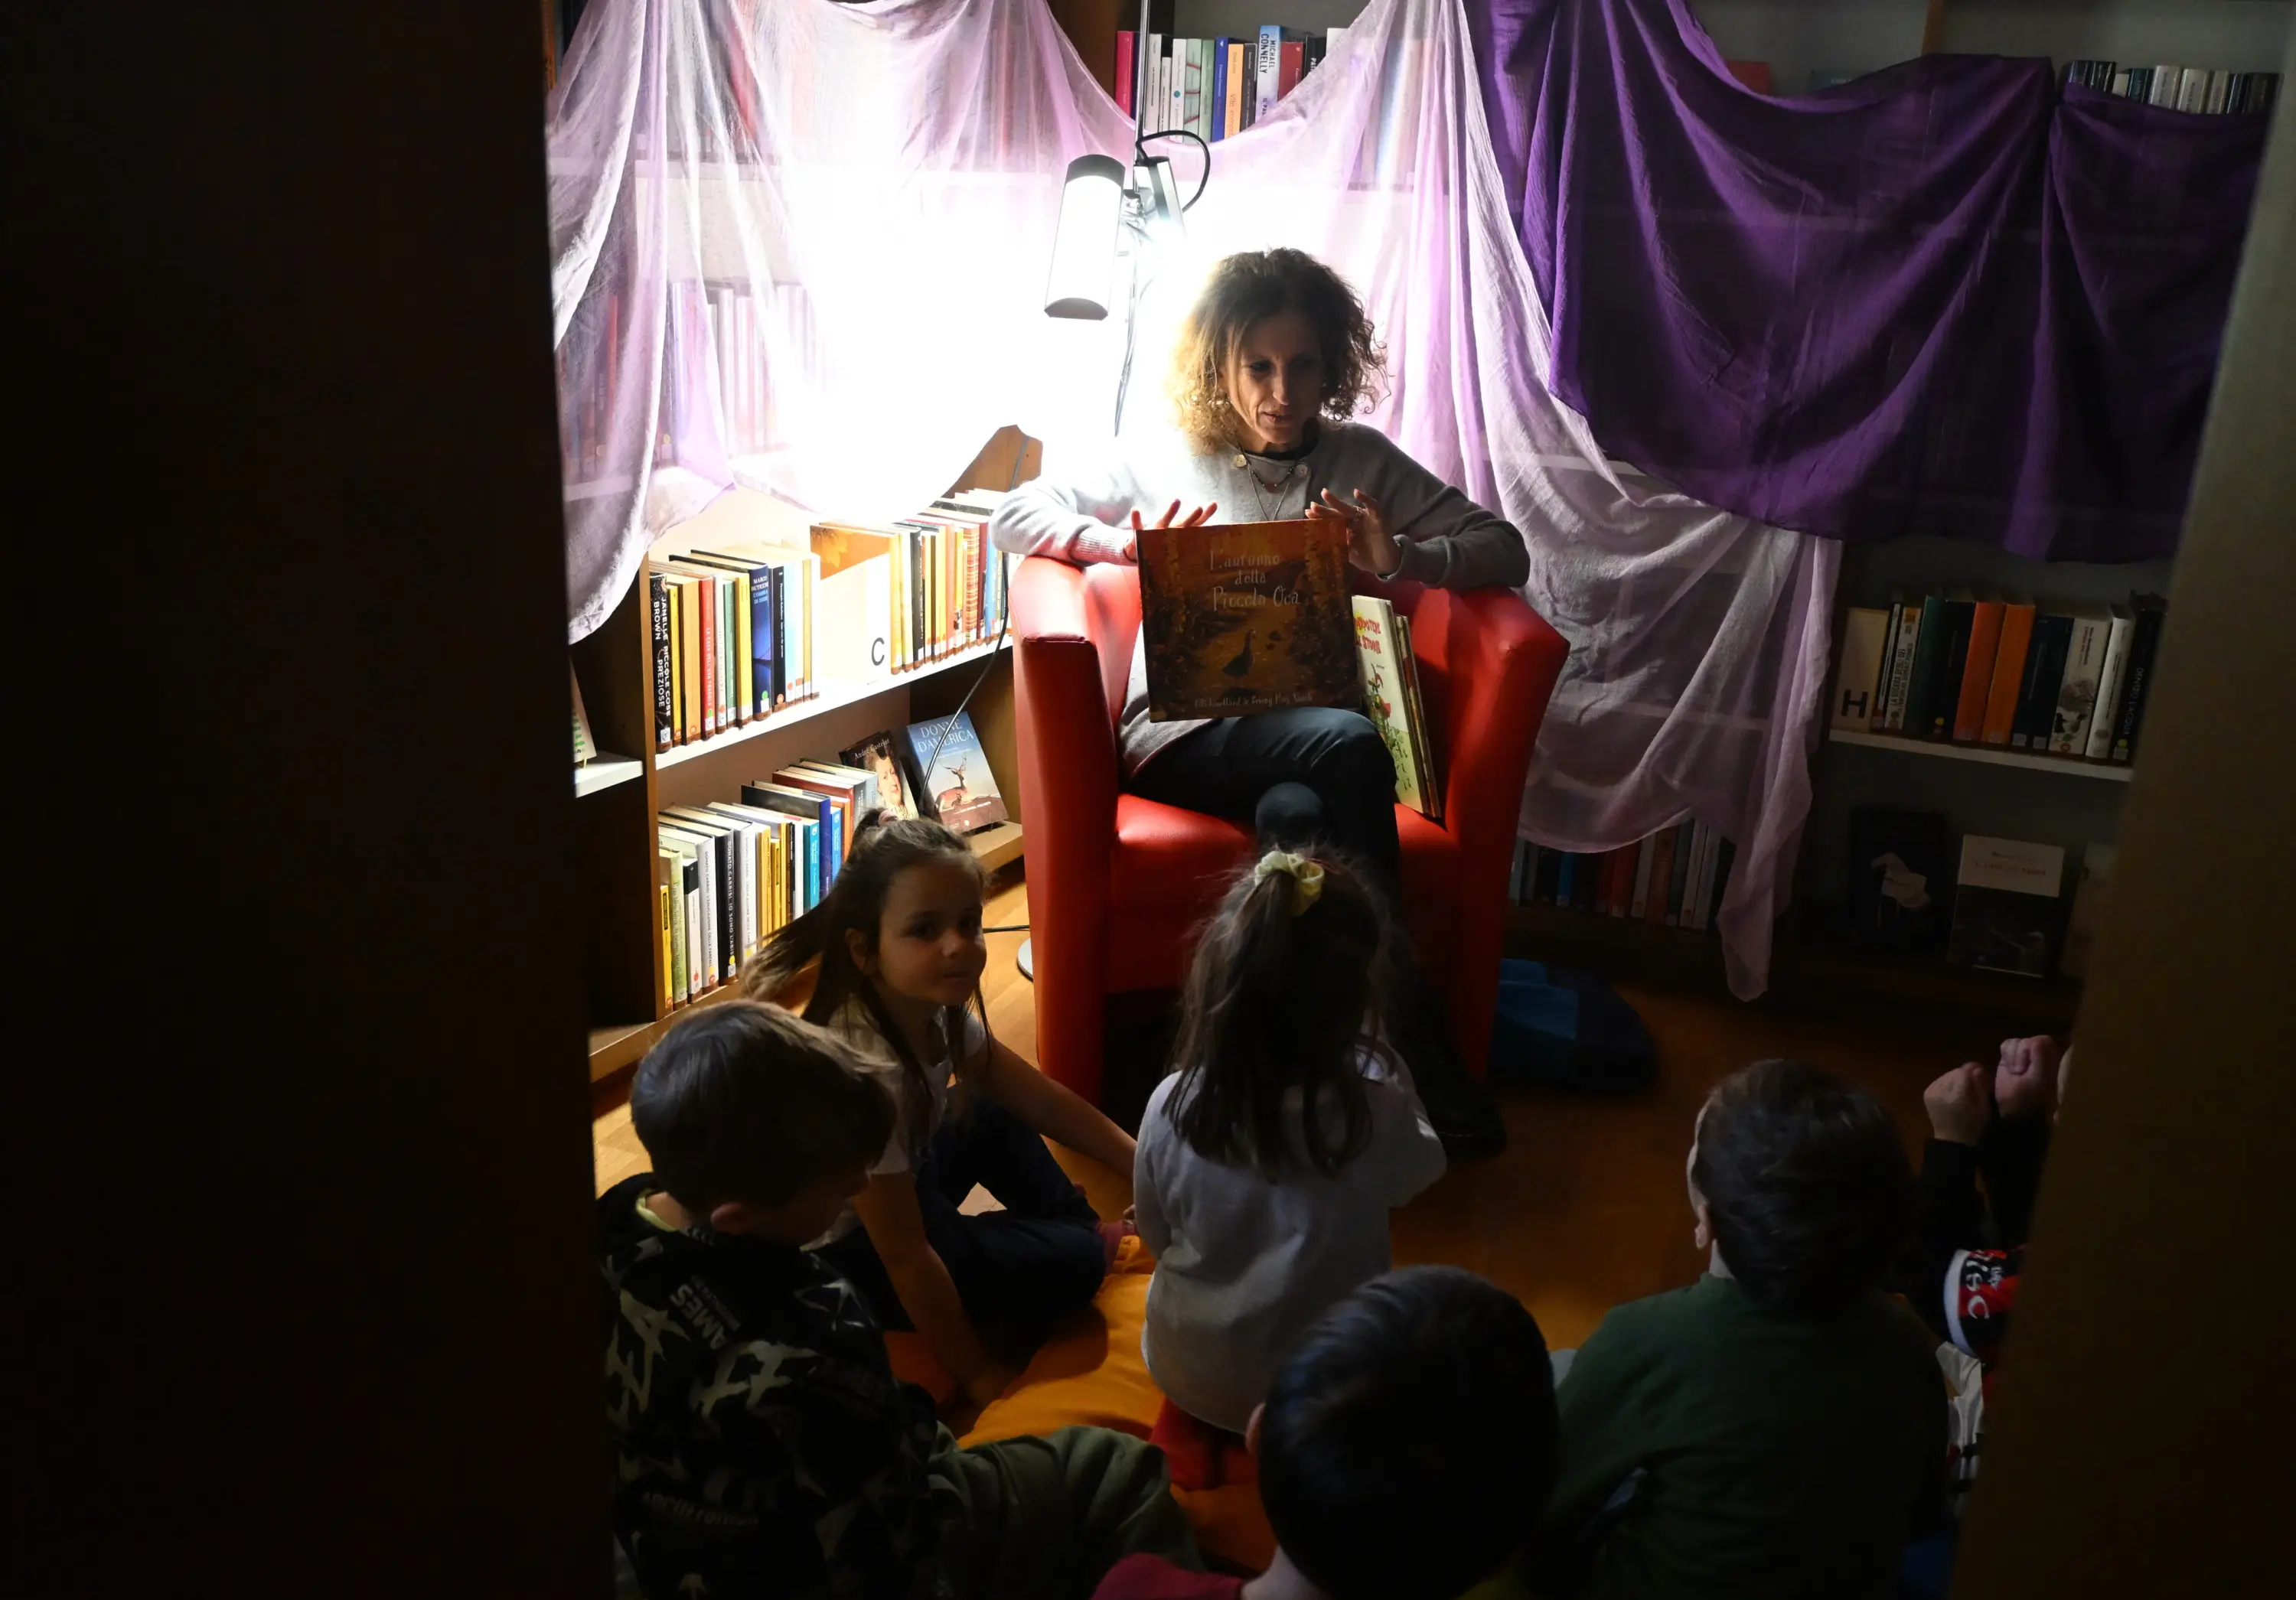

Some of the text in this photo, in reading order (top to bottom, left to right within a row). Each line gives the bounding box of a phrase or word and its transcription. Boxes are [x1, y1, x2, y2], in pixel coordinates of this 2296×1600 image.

[1260, 34, 1269, 73] CONNELLY
[1209, 549, 1280, 571] L'autunno
[753, 575, 767, 584] MARCO
[1235, 569, 1266, 585] della
[1212, 585, 1300, 612] Piccola Oca
[871, 637, 885, 666] C
[657, 660, 665, 707] PREZIOSE
[1841, 689, 1869, 719] H
[920, 719, 963, 738] DONNE
[726, 840, 734, 868] DONATO
